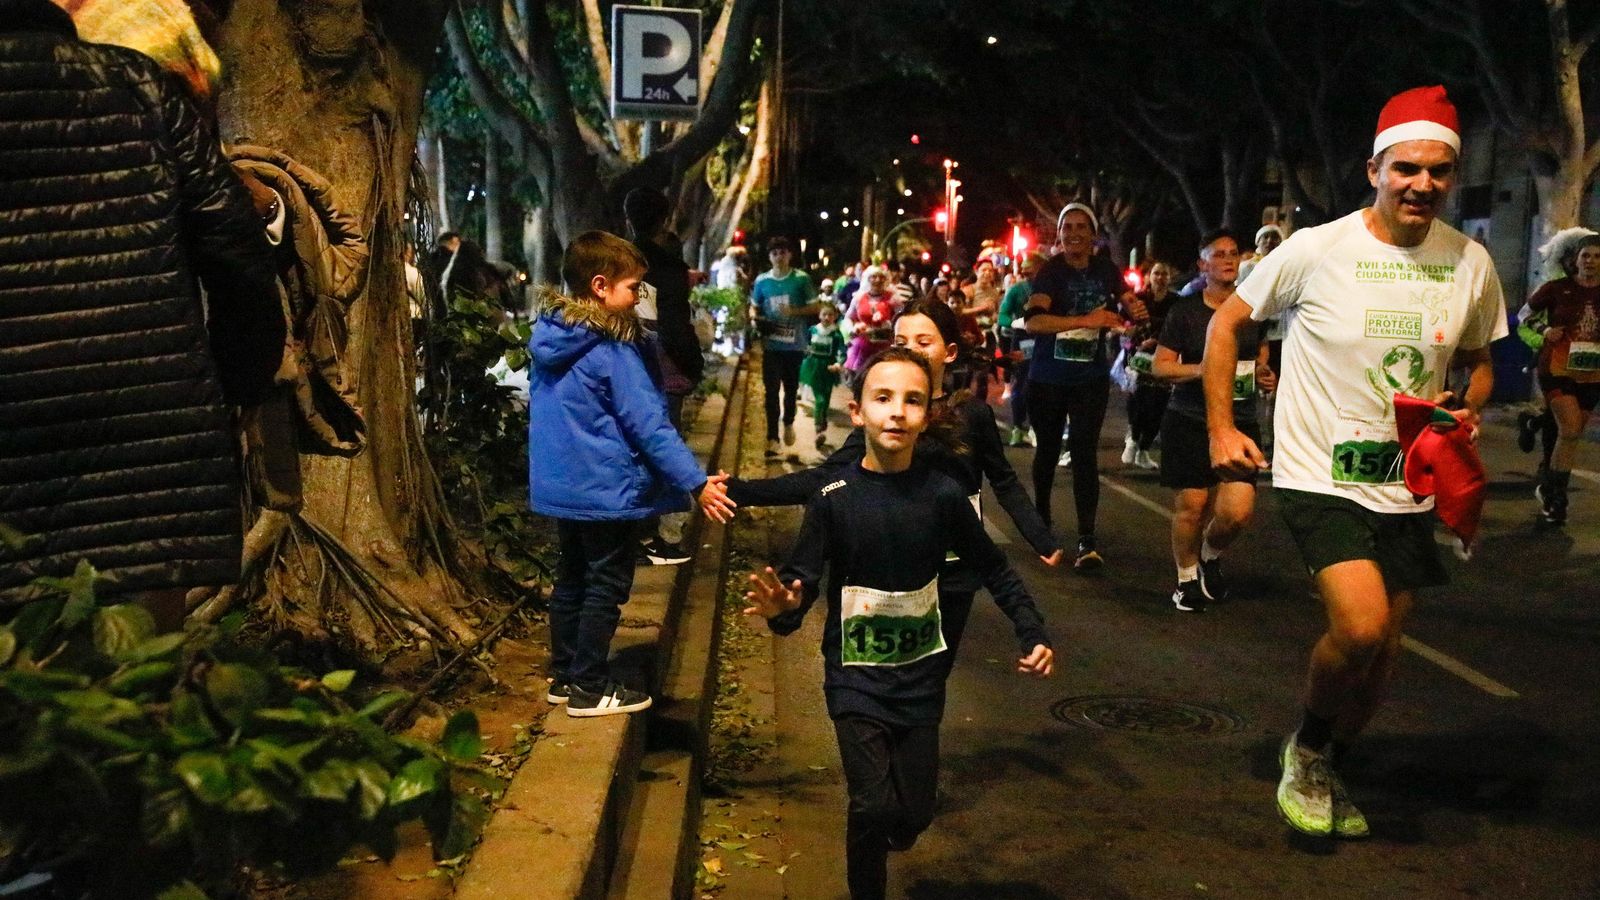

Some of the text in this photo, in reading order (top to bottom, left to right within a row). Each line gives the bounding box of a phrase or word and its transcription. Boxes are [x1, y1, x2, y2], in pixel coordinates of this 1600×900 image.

[622, 13, 692, 99] P
[644, 87, 670, 100] 24h
[1356, 261, 1456, 274] XVII SAN SILVESTRE
[1355, 271, 1397, 280] CIUDAD
[1400, 272, 1413, 281] DE
[1368, 319, 1421, 330] PROTEGE
[1381, 329, 1421, 337] ENTORNO
[849, 620, 936, 655] 1589
